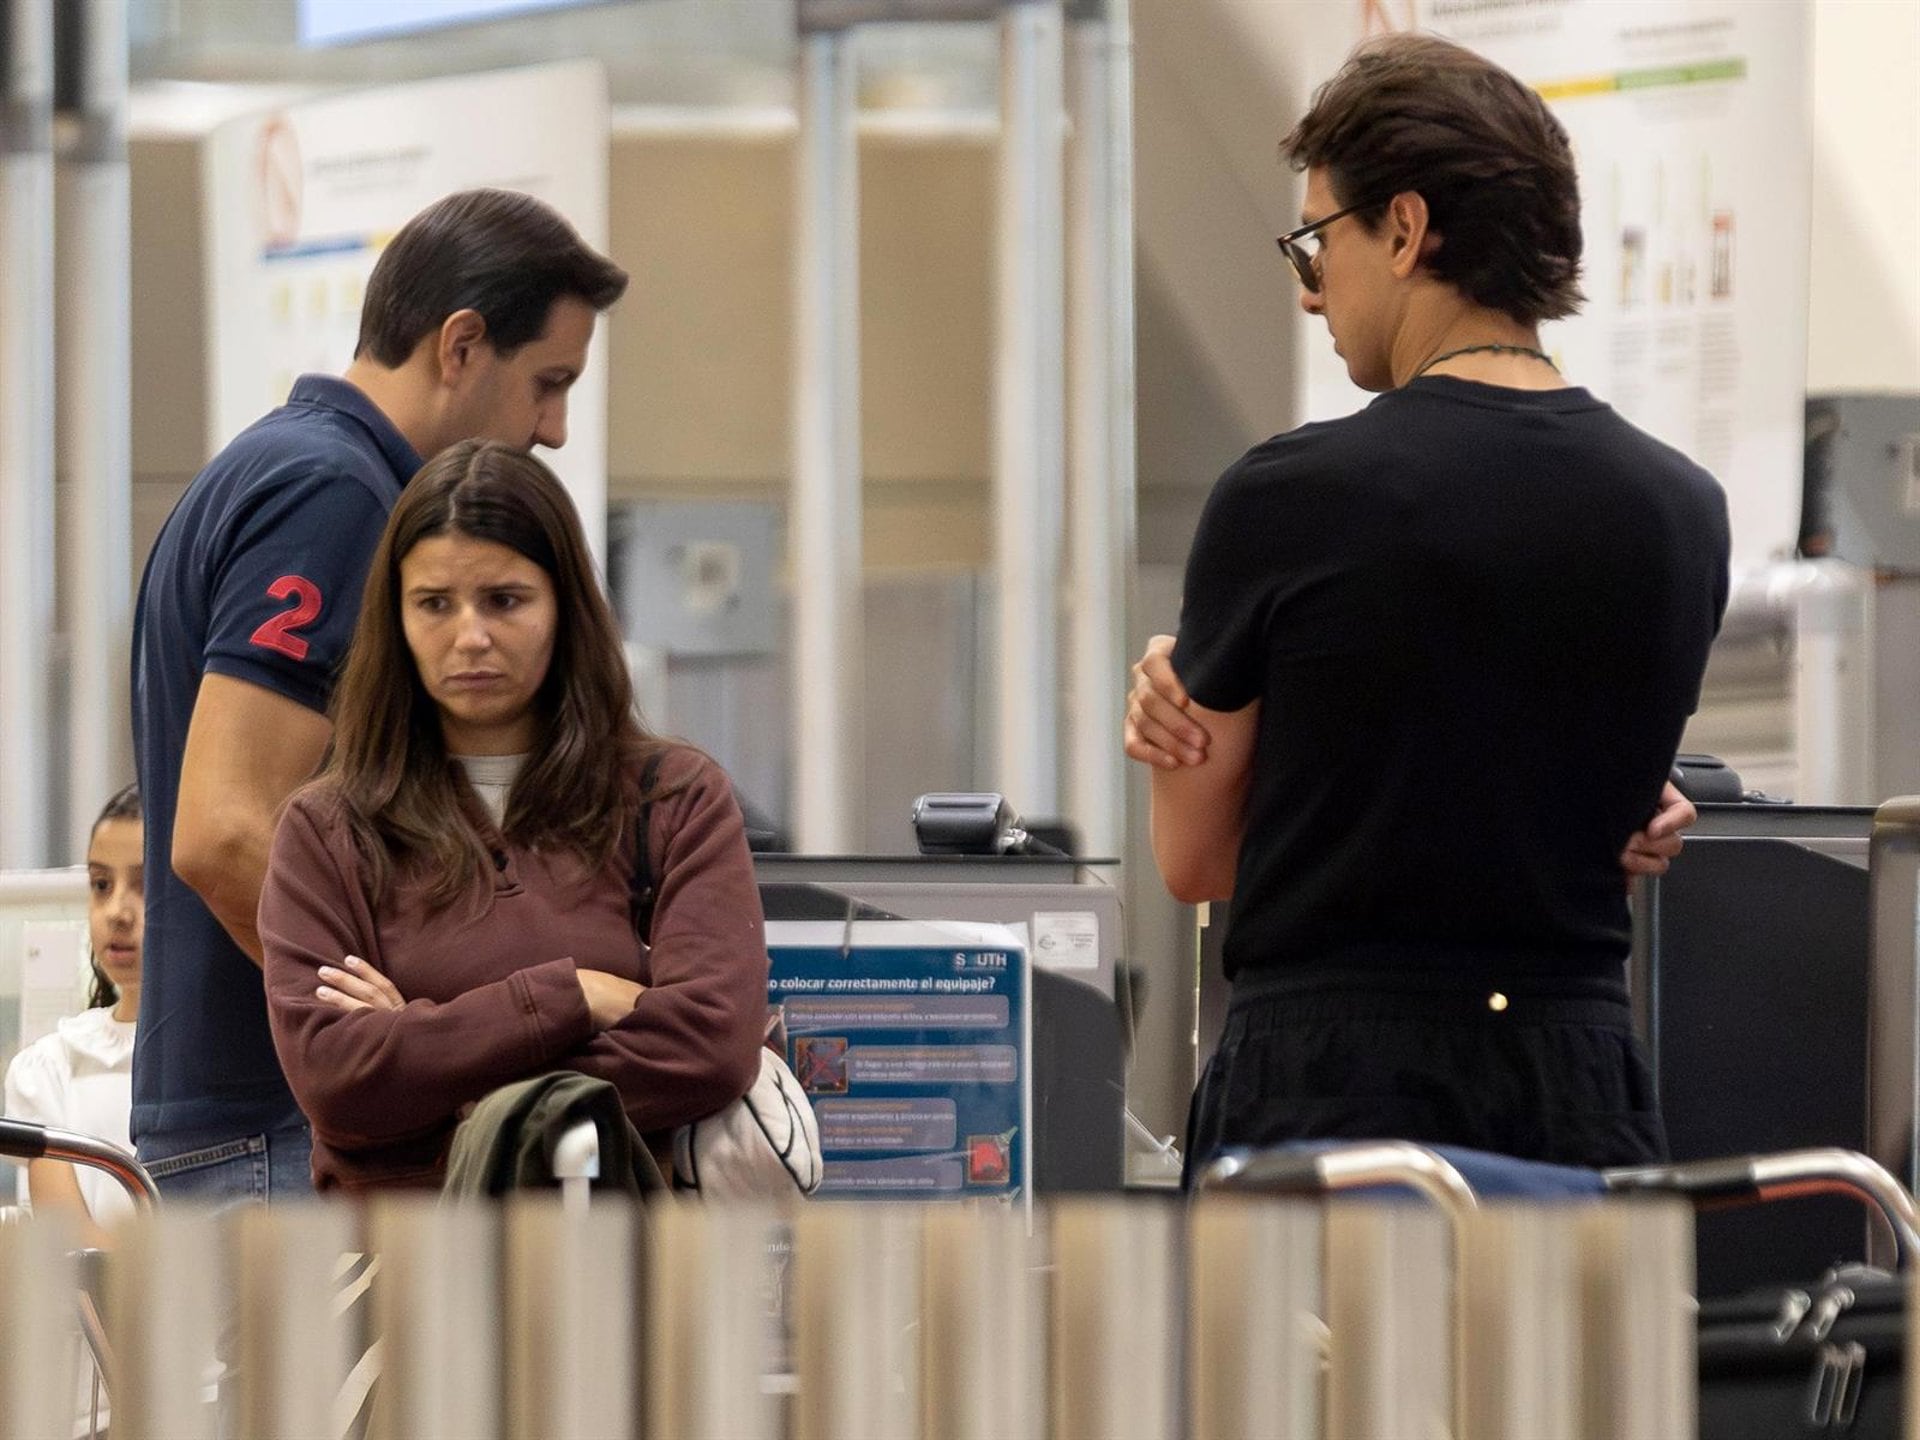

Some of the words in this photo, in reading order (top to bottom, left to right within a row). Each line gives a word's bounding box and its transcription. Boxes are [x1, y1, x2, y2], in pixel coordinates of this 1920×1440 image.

[249, 574, 323, 661] 2
[954, 952, 1007, 966] SUTH
[767, 979, 778, 989] o
[780, 976, 825, 989] colocar
[828, 977, 918, 989] correctamente
[921, 976, 933, 989] el
[935, 976, 996, 992] equipaje?
